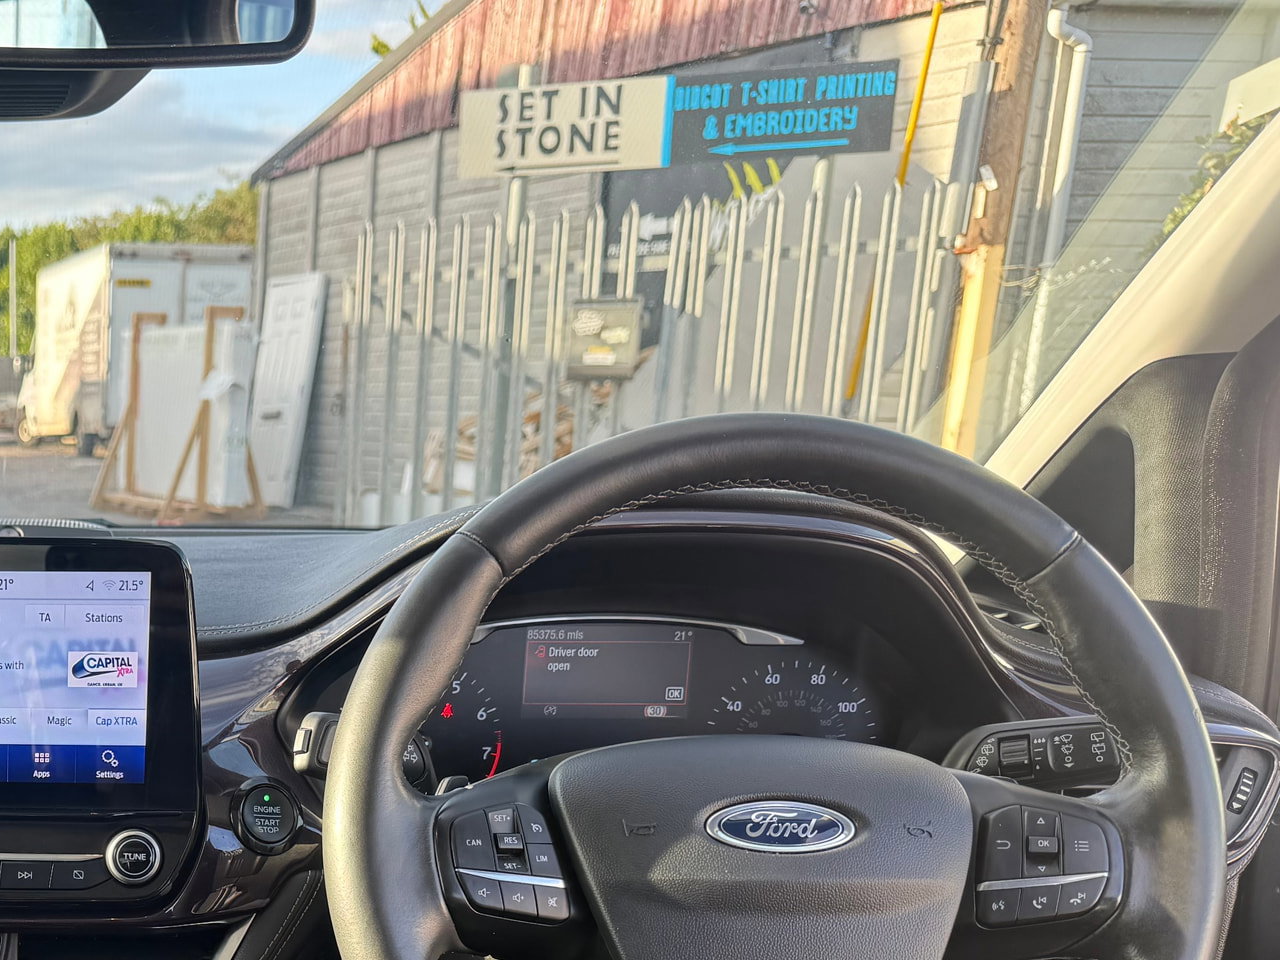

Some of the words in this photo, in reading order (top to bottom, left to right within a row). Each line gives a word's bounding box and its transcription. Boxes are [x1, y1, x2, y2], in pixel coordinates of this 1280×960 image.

[741, 77, 807, 106] T-SHIRT
[815, 70, 897, 101] PRINTING
[499, 89, 559, 123] SET
[580, 84, 622, 117] IN
[702, 114, 720, 140] &
[724, 105, 859, 139] EMBROIDERY
[497, 121, 619, 159] STONE
[118, 579, 144, 592] 21.5°
[39, 612, 51, 622] TA
[85, 612, 123, 623] Stations
[527, 630, 565, 640] 85375.6
[548, 646, 576, 657] Driver
[577, 646, 599, 657] door
[5, 659, 25, 670] with
[86, 656, 132, 669] CAPITAL
[547, 661, 570, 672] open
[116, 667, 134, 677] XTRA
[764, 674, 780, 685] 60
[810, 674, 826, 685] 80
[451, 681, 462, 694] 5
[668, 688, 682, 699] OK
[650, 706, 662, 717] 30
[727, 701, 742, 712] 40
[837, 702, 858, 713] 100
[477, 708, 487, 720] 6
[46, 715, 72, 727] Magic
[95, 716, 112, 728] Cap
[113, 717, 138, 726] XTRA
[482, 747, 492, 760] 7
[33, 770, 51, 779] Apps
[95, 770, 124, 780] Settings
[253, 805, 281, 814] ENGINE
[255, 818, 280, 826] START
[745, 812, 819, 839] Ford
[123, 851, 147, 862] TUNE
